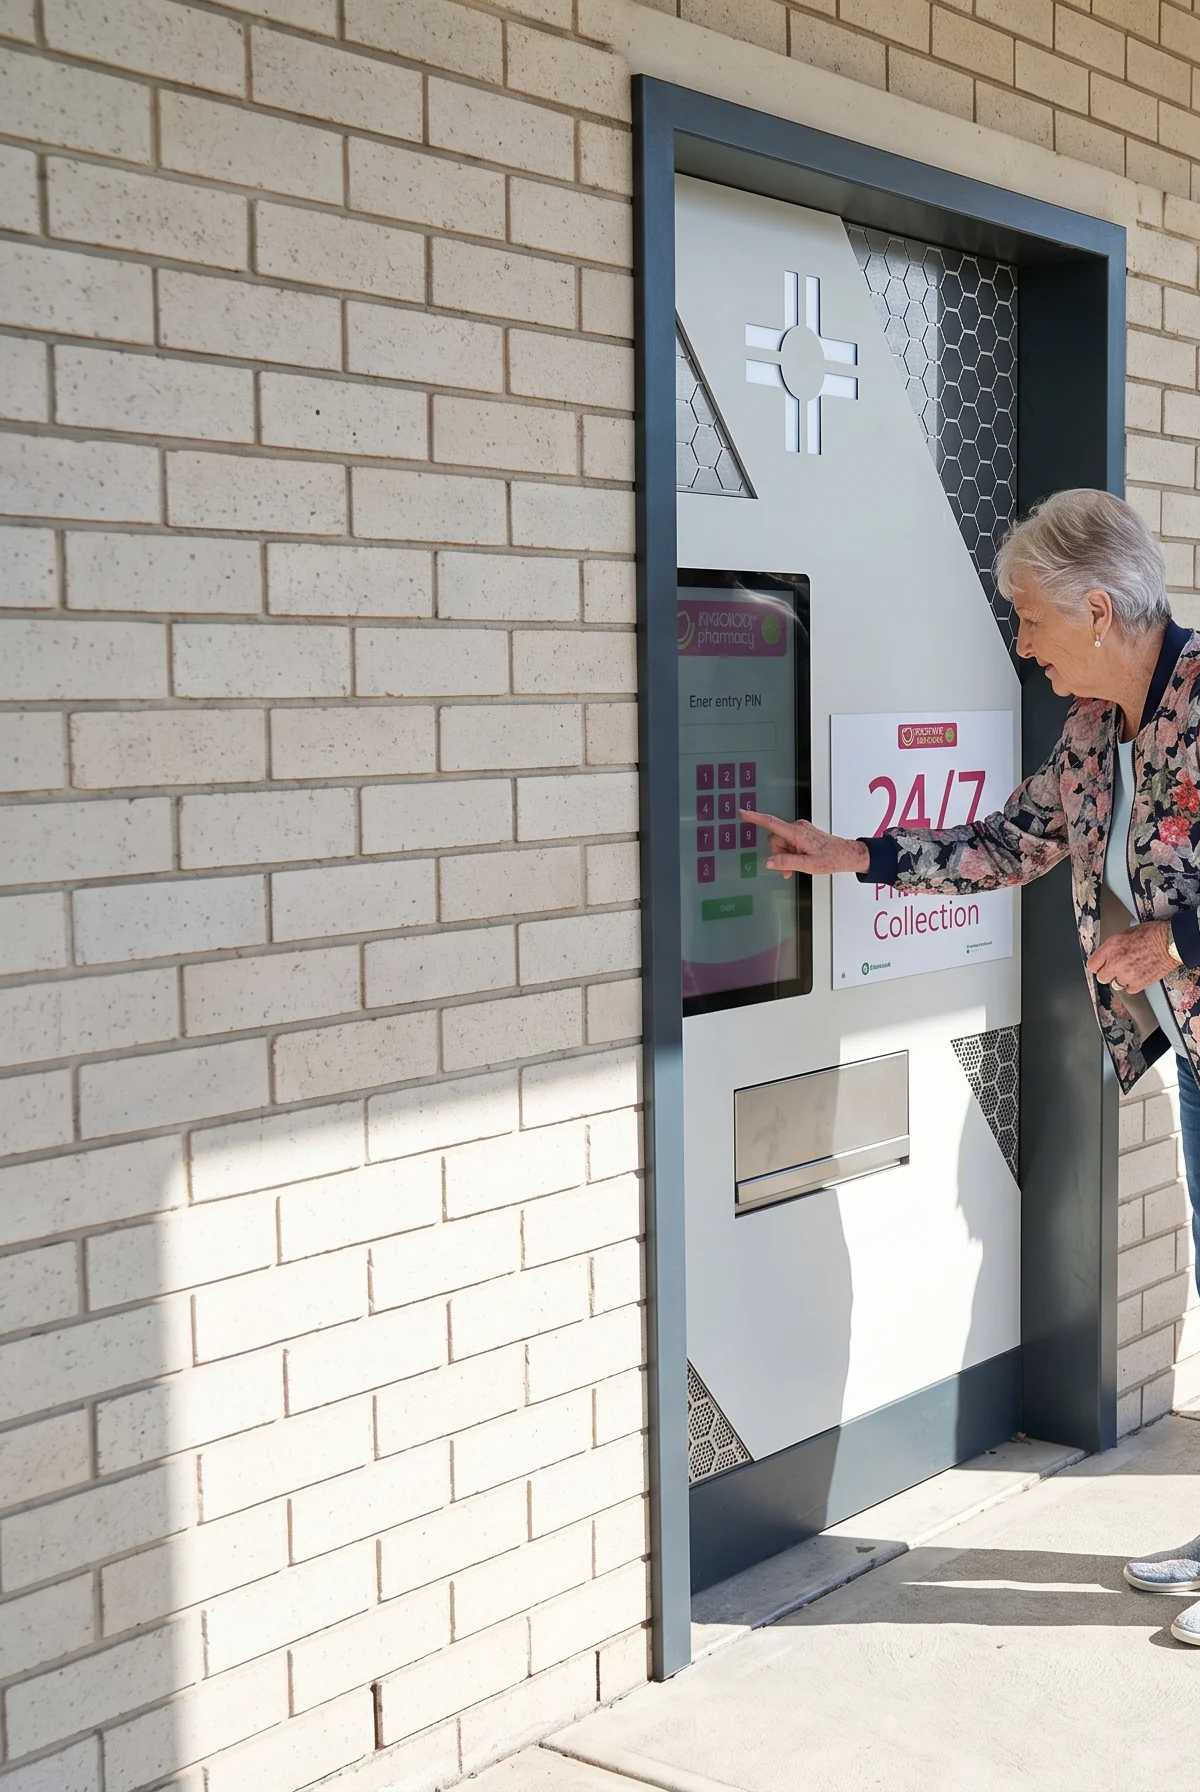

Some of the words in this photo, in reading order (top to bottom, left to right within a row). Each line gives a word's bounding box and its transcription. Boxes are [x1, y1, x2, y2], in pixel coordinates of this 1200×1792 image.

[697, 628, 755, 649] pharmacy
[689, 695, 712, 708] Ener
[715, 696, 743, 710] entry
[745, 694, 762, 707] PIN
[868, 769, 986, 838] 24/7
[873, 900, 979, 940] Collection
